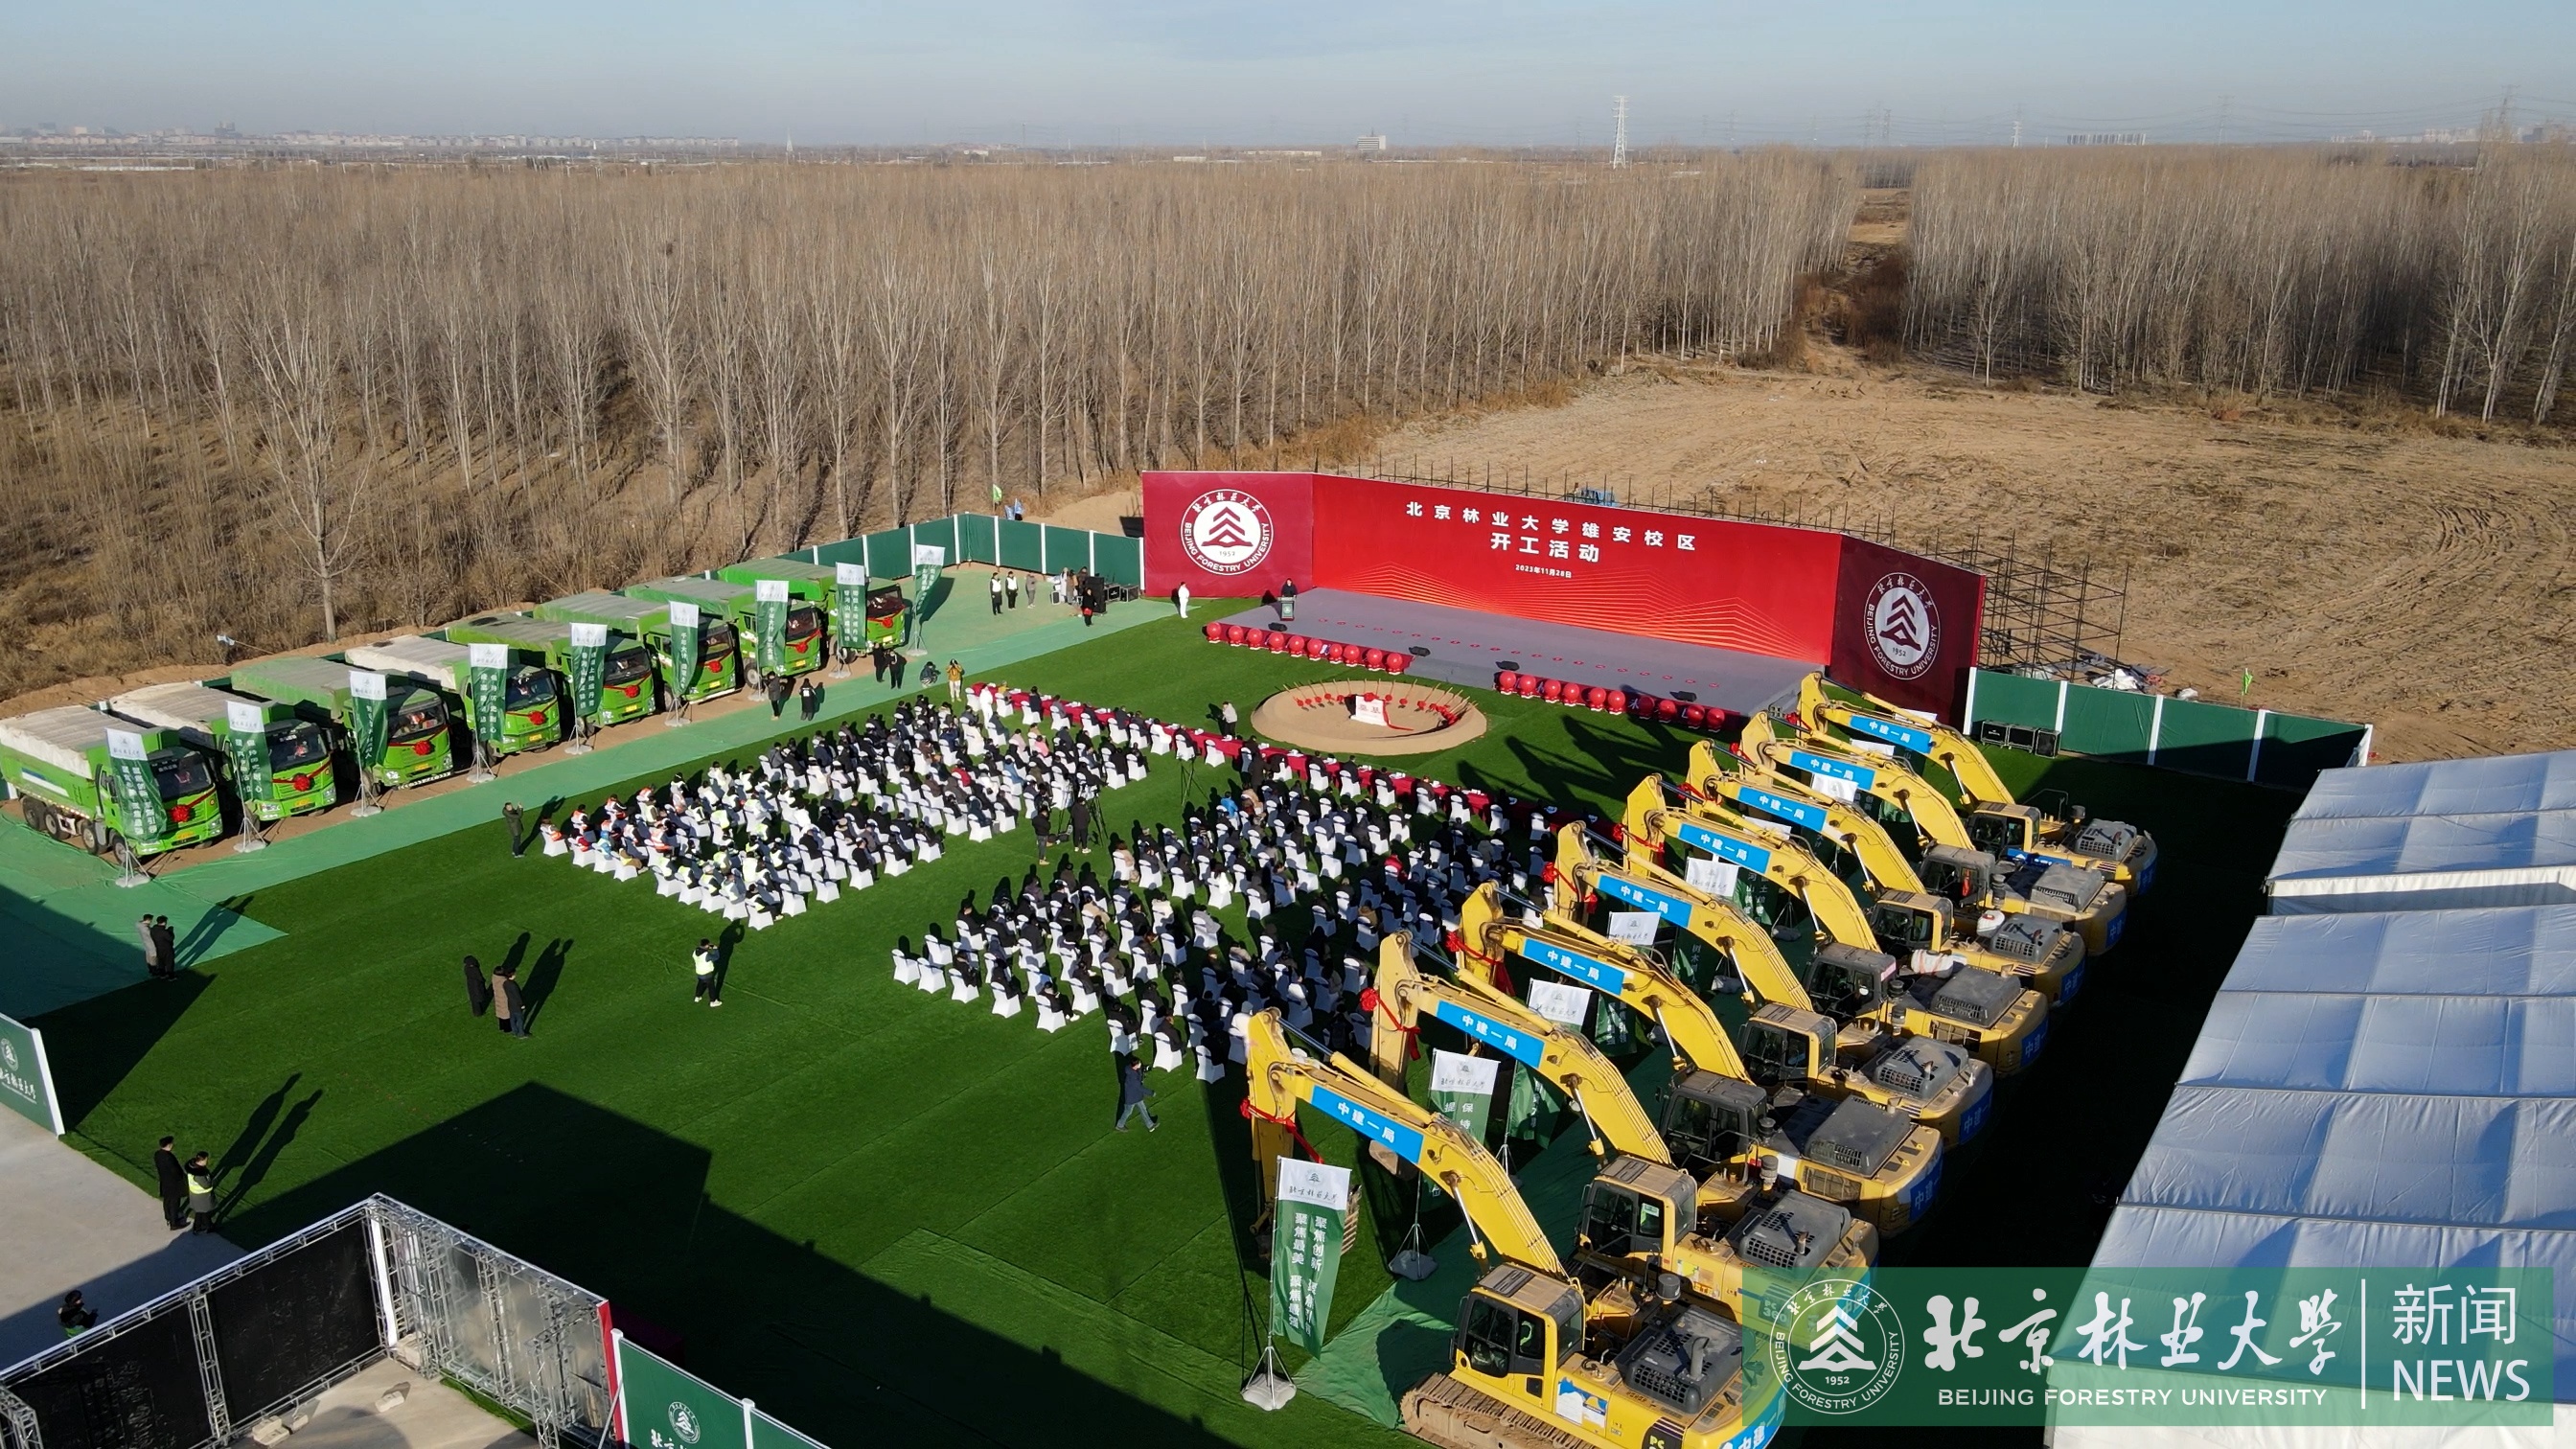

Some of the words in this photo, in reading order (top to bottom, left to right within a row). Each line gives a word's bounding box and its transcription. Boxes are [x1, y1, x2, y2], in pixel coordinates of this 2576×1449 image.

[1406, 501, 1696, 551] 北京林业大学雄安校区
[1184, 522, 1198, 555] BEIJING
[1196, 555, 1241, 571] FORESTRY
[1244, 522, 1270, 567] UNIVERSITY
[1490, 532, 1599, 564] 开工活动
[1515, 564, 1573, 579] 2023年11月28日
[1866, 603, 1876, 644] BEIJING
[1874, 646, 1909, 677] FORESTRY
[1912, 624, 1938, 675] UNIVERSITY
[1892, 647, 1906, 656] 1952
[1869, 721, 1911, 744] 中建一局
[1810, 758, 1854, 781] 中建一局
[1759, 794, 1805, 819] 中建一局
[1700, 833, 1748, 862] 中建一局
[1621, 885, 1669, 914] 中建一局
[1547, 950, 1599, 981] 中建一局
[1461, 1014, 1517, 1051] 中建一局
[1337, 1101, 1395, 1144] 中建一局
[1291, 1212, 1308, 1266] 聚焦最美
[1310, 1215, 1327, 1272] 聚焦创新
